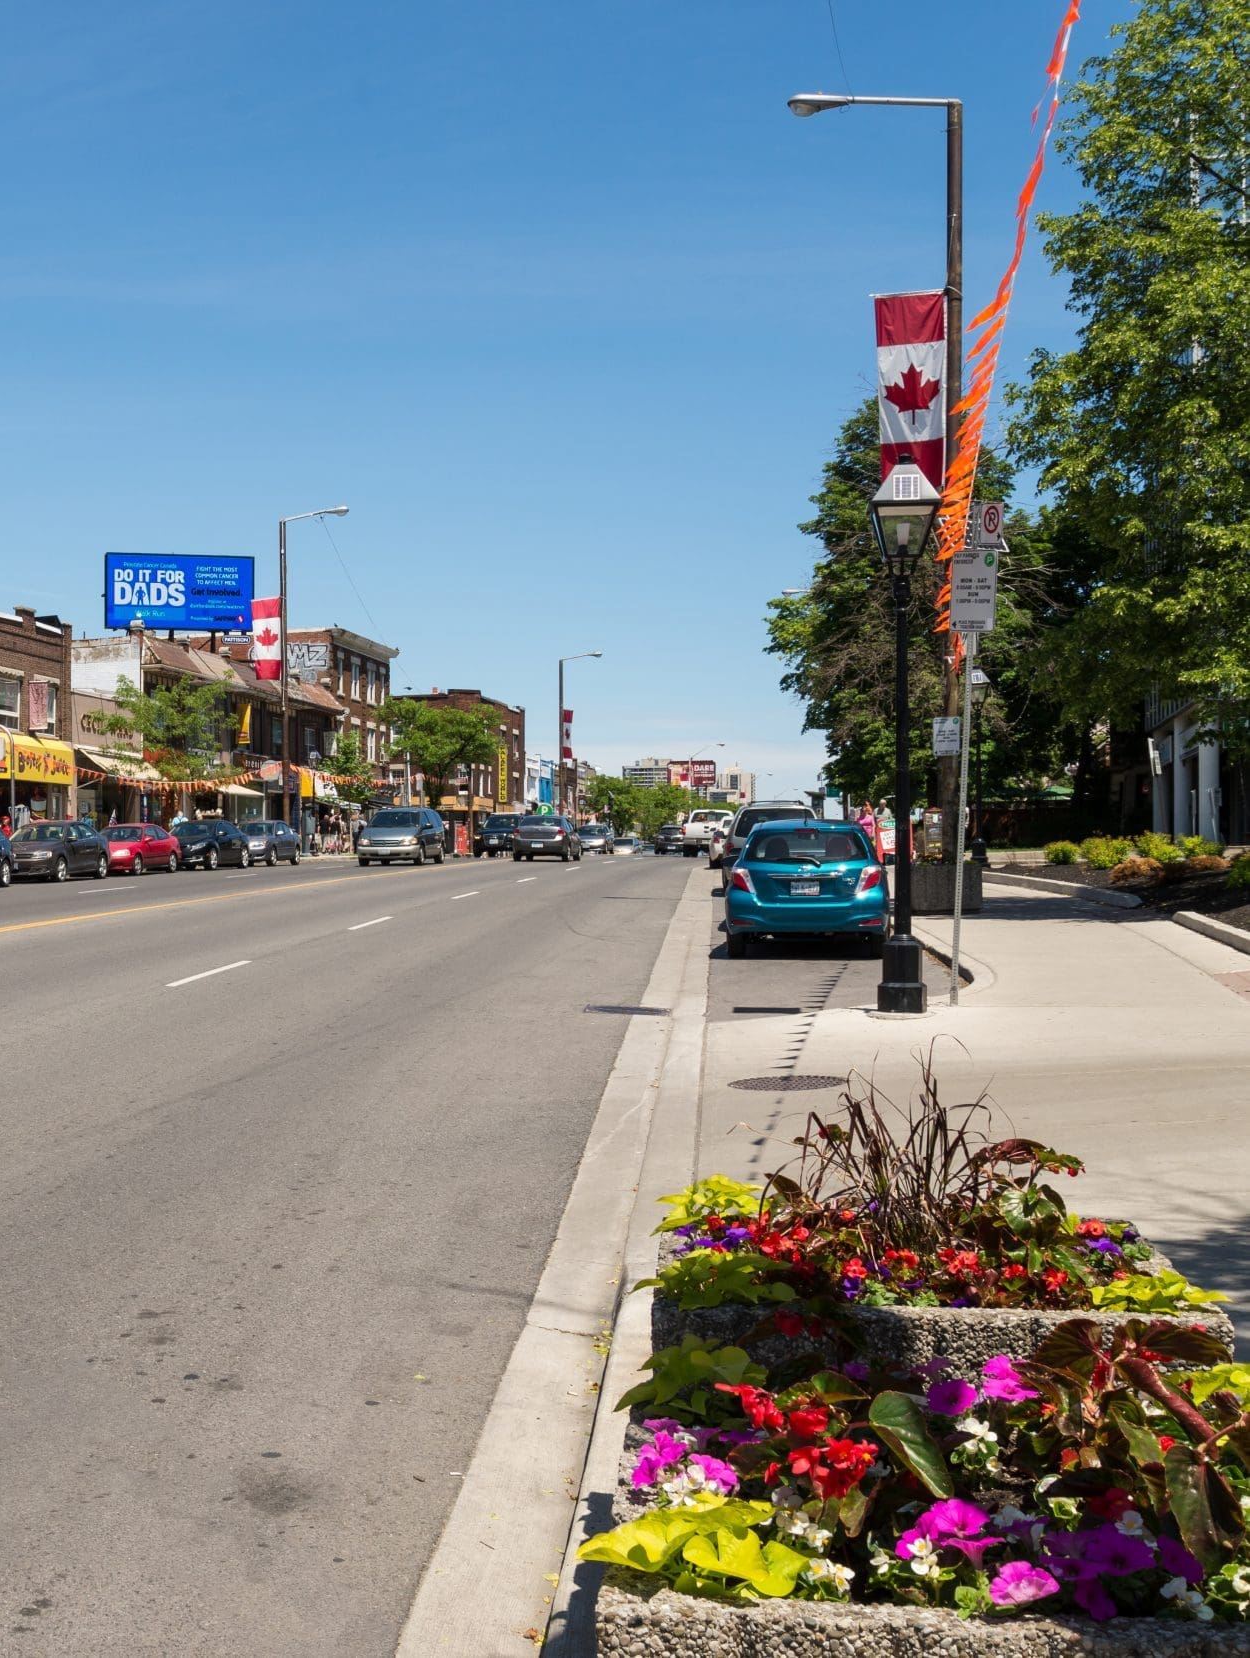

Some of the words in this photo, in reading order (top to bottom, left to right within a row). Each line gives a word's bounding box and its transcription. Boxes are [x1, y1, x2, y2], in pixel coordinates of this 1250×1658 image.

[113, 569, 134, 581] DO
[139, 569, 152, 582] IT
[157, 570, 185, 584] FOR
[113, 581, 186, 607] DADS
[191, 587, 205, 597] Get
[693, 764, 715, 772] DARE
